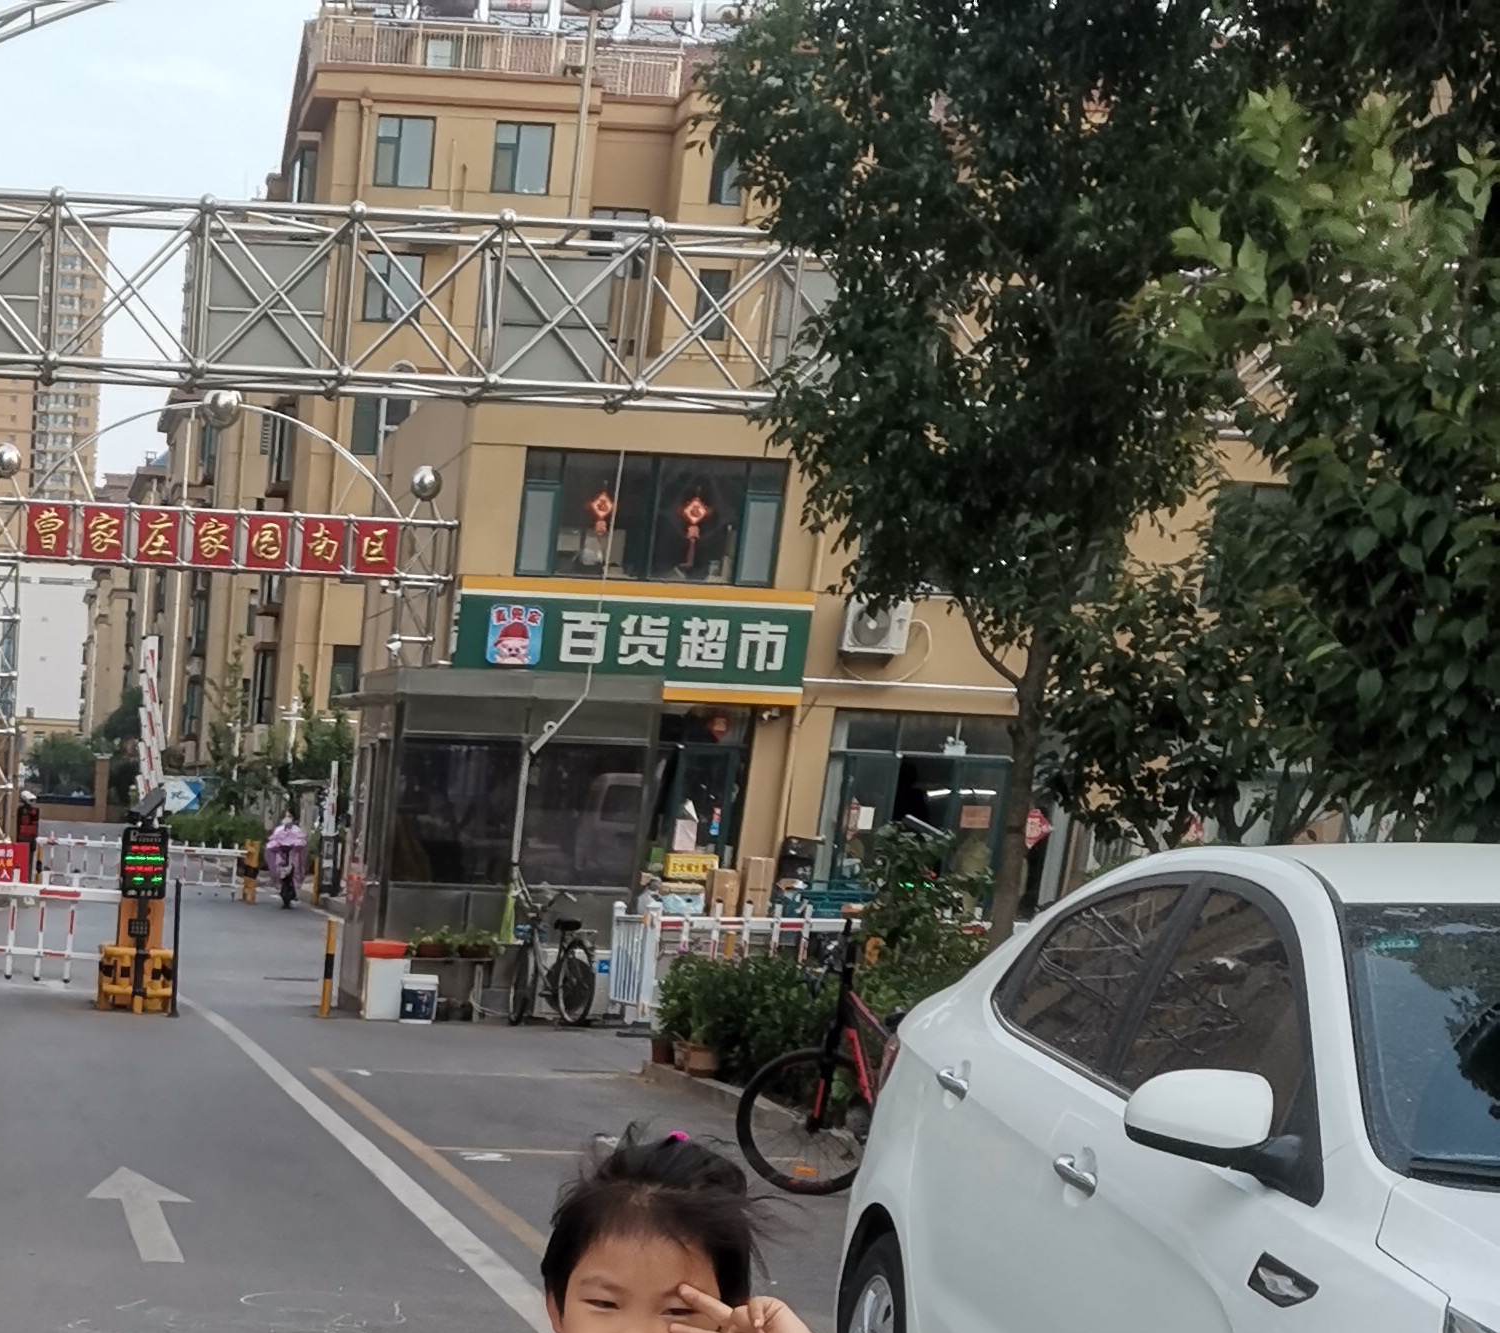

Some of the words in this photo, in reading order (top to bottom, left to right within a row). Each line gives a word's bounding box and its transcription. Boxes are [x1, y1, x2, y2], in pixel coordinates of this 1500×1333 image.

[33, 507, 389, 565] 曾家庄家园南区
[559, 611, 789, 672] 百货超市
